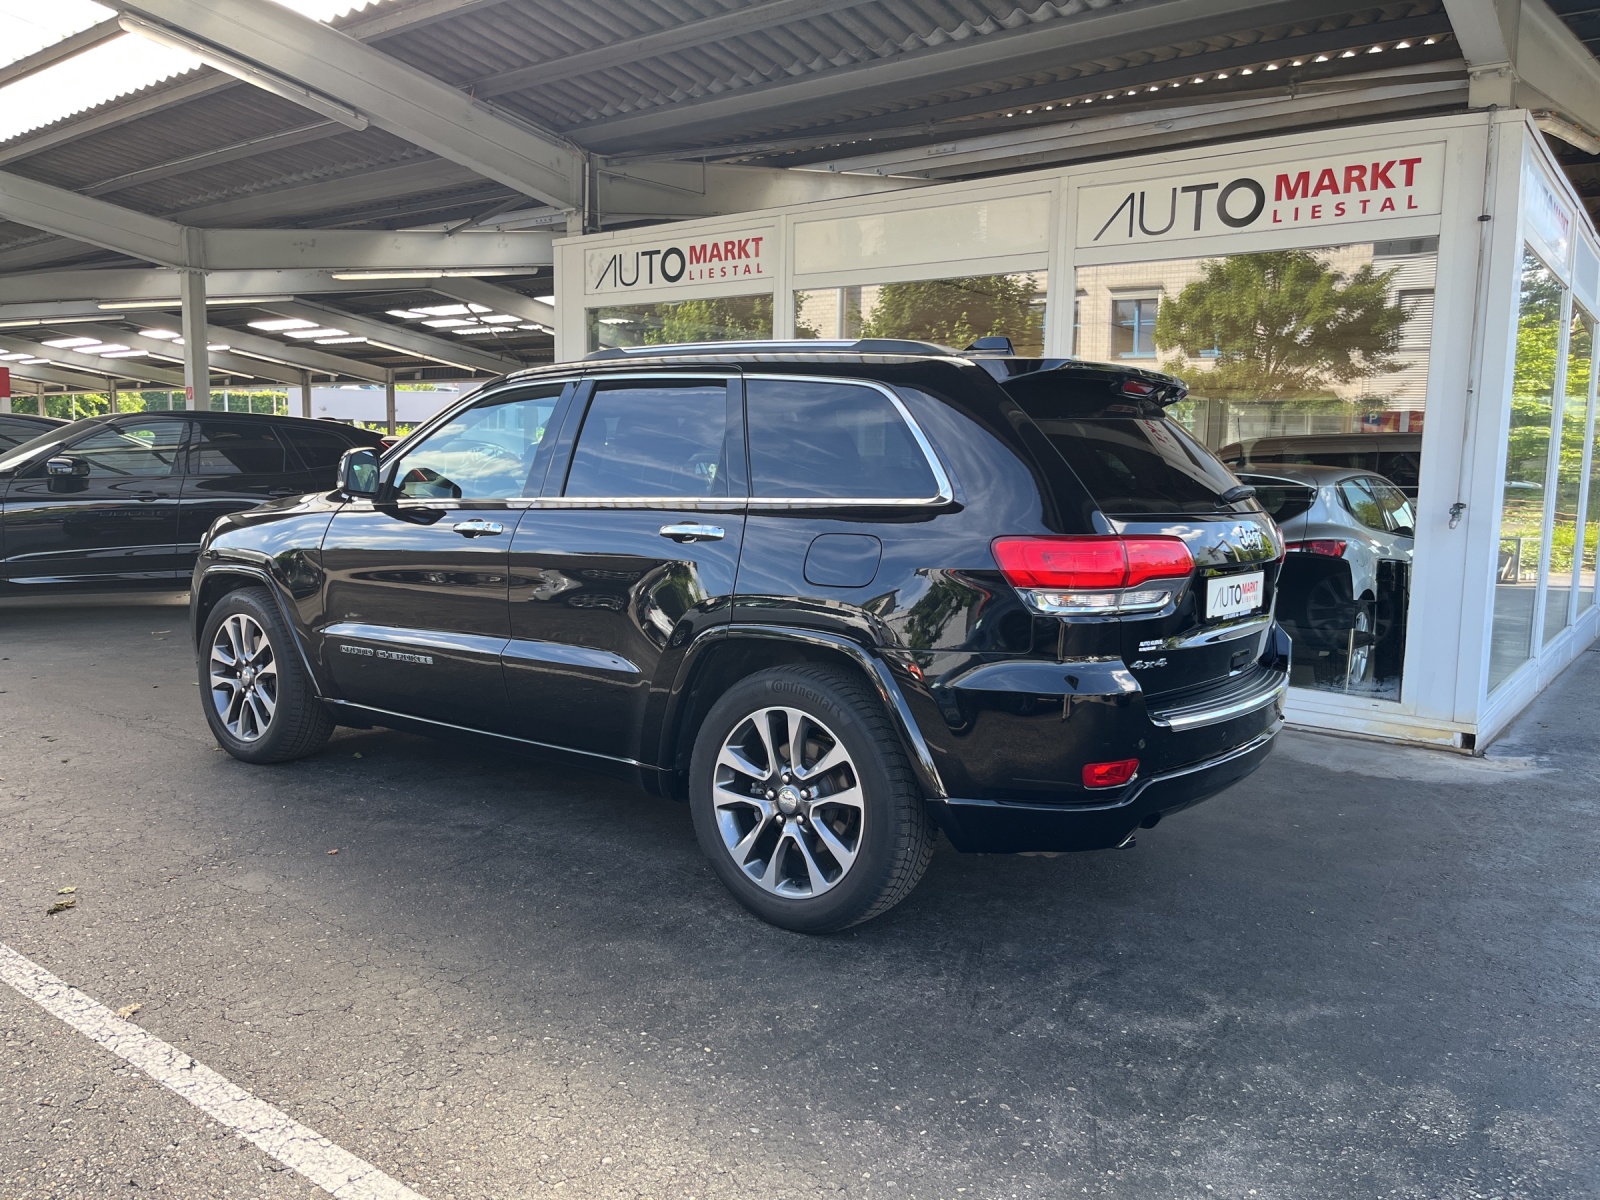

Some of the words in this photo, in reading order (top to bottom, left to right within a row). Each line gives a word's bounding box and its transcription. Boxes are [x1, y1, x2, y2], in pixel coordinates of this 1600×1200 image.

[1093, 177, 1265, 241] AUTO
[1274, 157, 1422, 202] MARKT
[1272, 195, 1418, 223] LIESTAL
[595, 247, 686, 289] AUTO
[689, 237, 763, 265] MARKT
[689, 263, 763, 280] LIESTAL
[1213, 584, 1242, 609] AUTO
[1242, 581, 1259, 594] MARKT
[1130, 658, 1167, 669] 4x4
[771, 679, 835, 713] Continental
